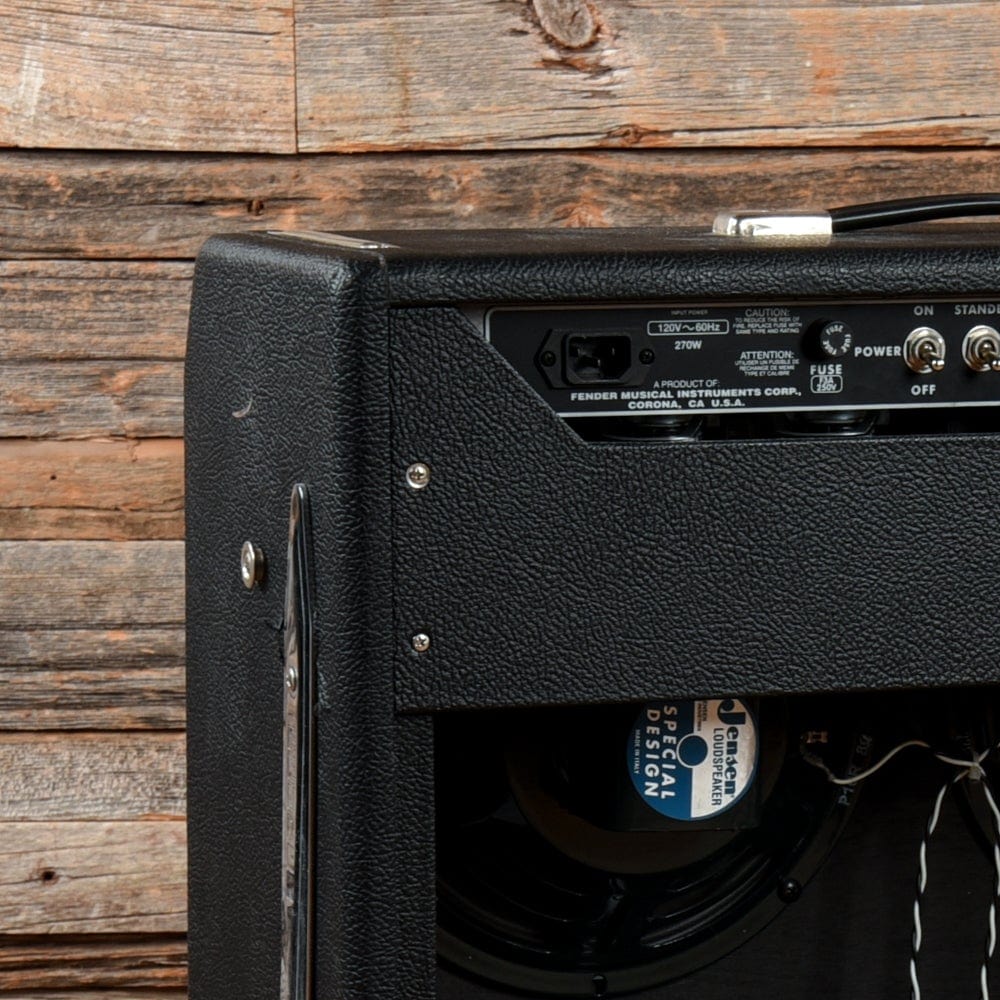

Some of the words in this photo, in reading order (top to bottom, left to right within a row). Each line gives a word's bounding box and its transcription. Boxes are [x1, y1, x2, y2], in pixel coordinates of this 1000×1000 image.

[745, 308, 790, 317] CAUTION:
[913, 305, 934, 316] ON
[674, 340, 702, 350] 270W
[740, 351, 794, 360] ATTENTION:
[854, 346, 902, 358] POWER
[810, 364, 843, 375] FUSE
[653, 381, 661, 389] A
[661, 380, 704, 388] PRODUCT
[706, 379, 720, 388] OF:
[570, 391, 618, 401] FENDER
[621, 390, 674, 400] MUSICAL
[677, 388, 761, 398] INSTRUMENTS
[764, 387, 802, 397] CORP.,
[911, 385, 936, 396] OFF
[628, 400, 682, 410] CORONA,
[688, 400, 705, 408] CA
[711, 399, 745, 408] U.S.A.
[644, 709, 661, 797] DESIGN
[661, 705, 678, 799] SPECIAL
[717, 700, 746, 796] Jensen
[711, 728, 725, 806] LOUDSPEAKER
